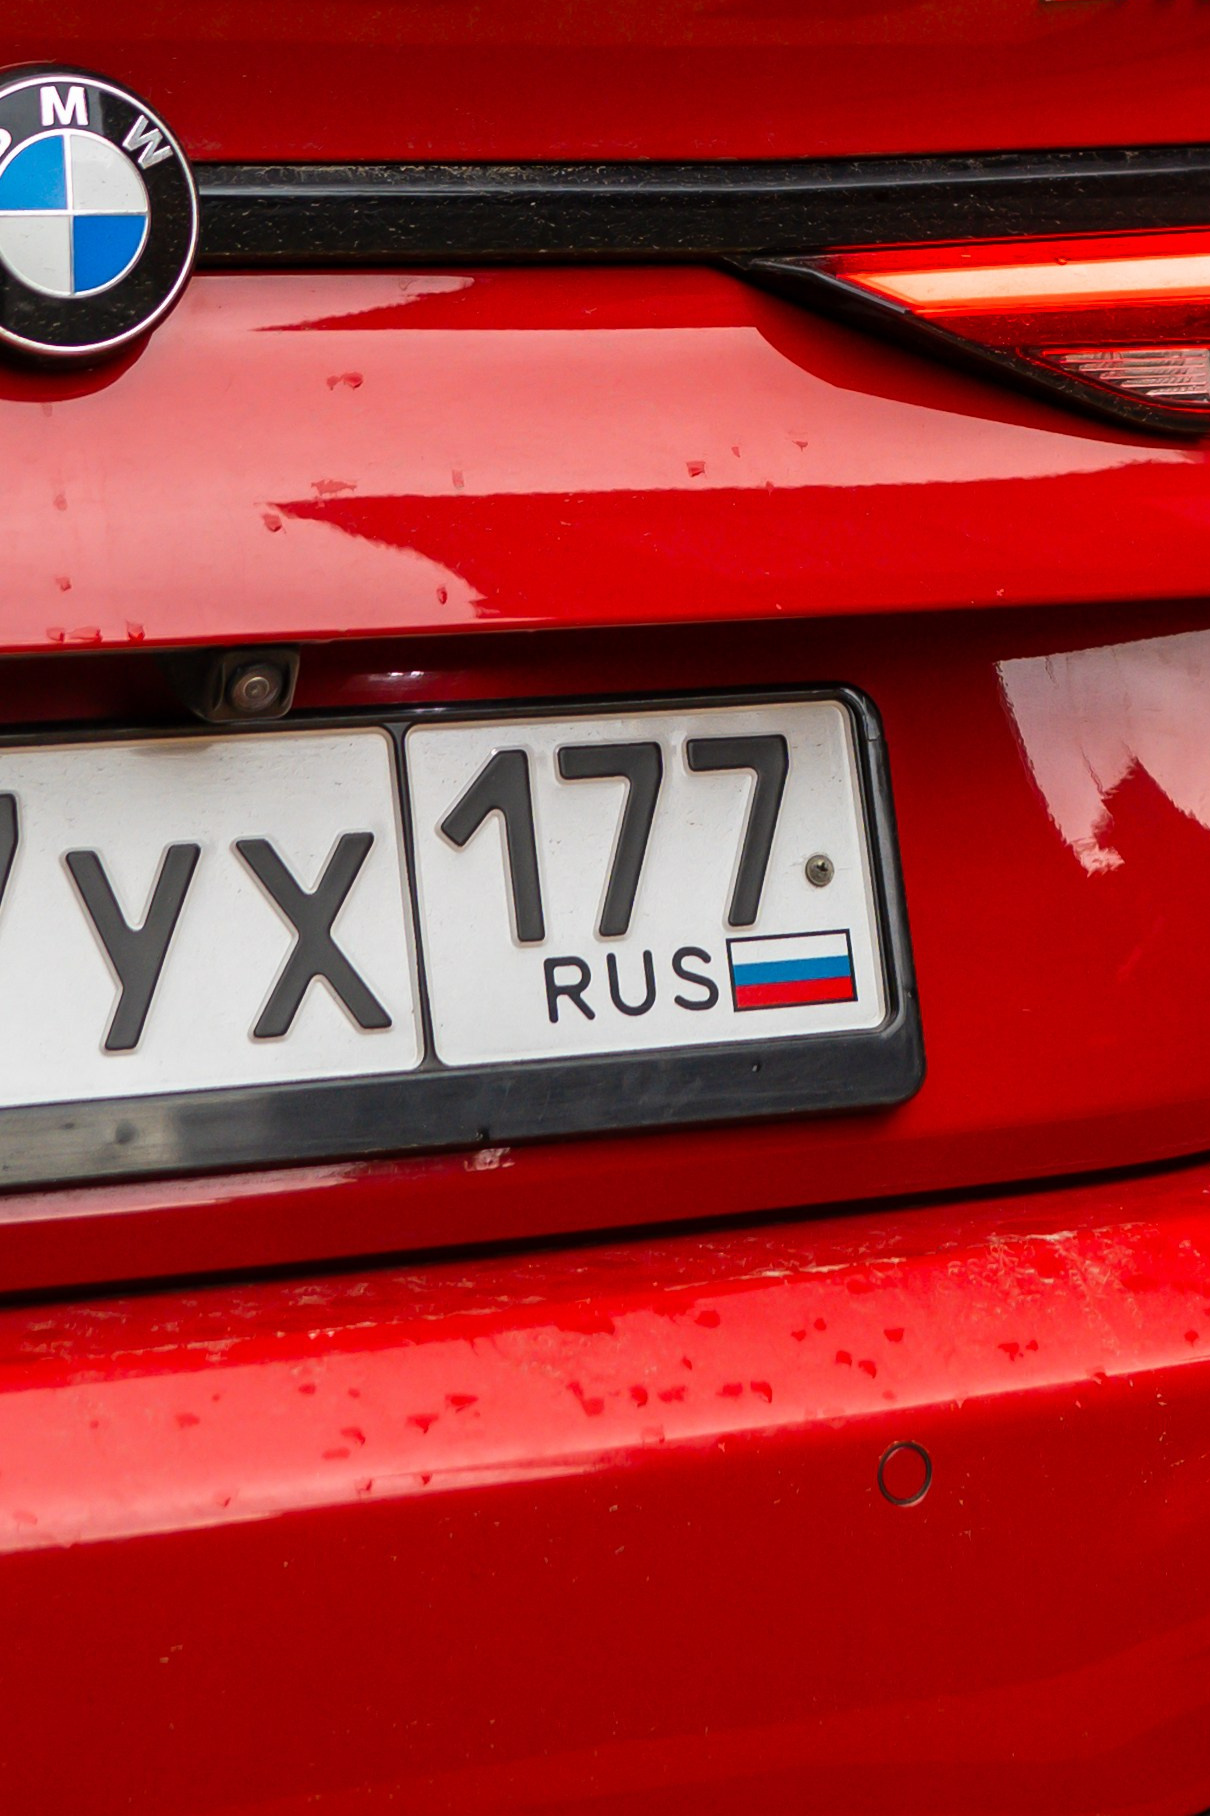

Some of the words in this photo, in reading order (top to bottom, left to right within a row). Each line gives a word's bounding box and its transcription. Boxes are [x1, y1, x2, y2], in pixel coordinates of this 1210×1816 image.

[0, 86, 173, 169] MW
[0, 793, 392, 1051] YX
[440, 734, 789, 943] 177
[543, 946, 719, 1024] RUS
